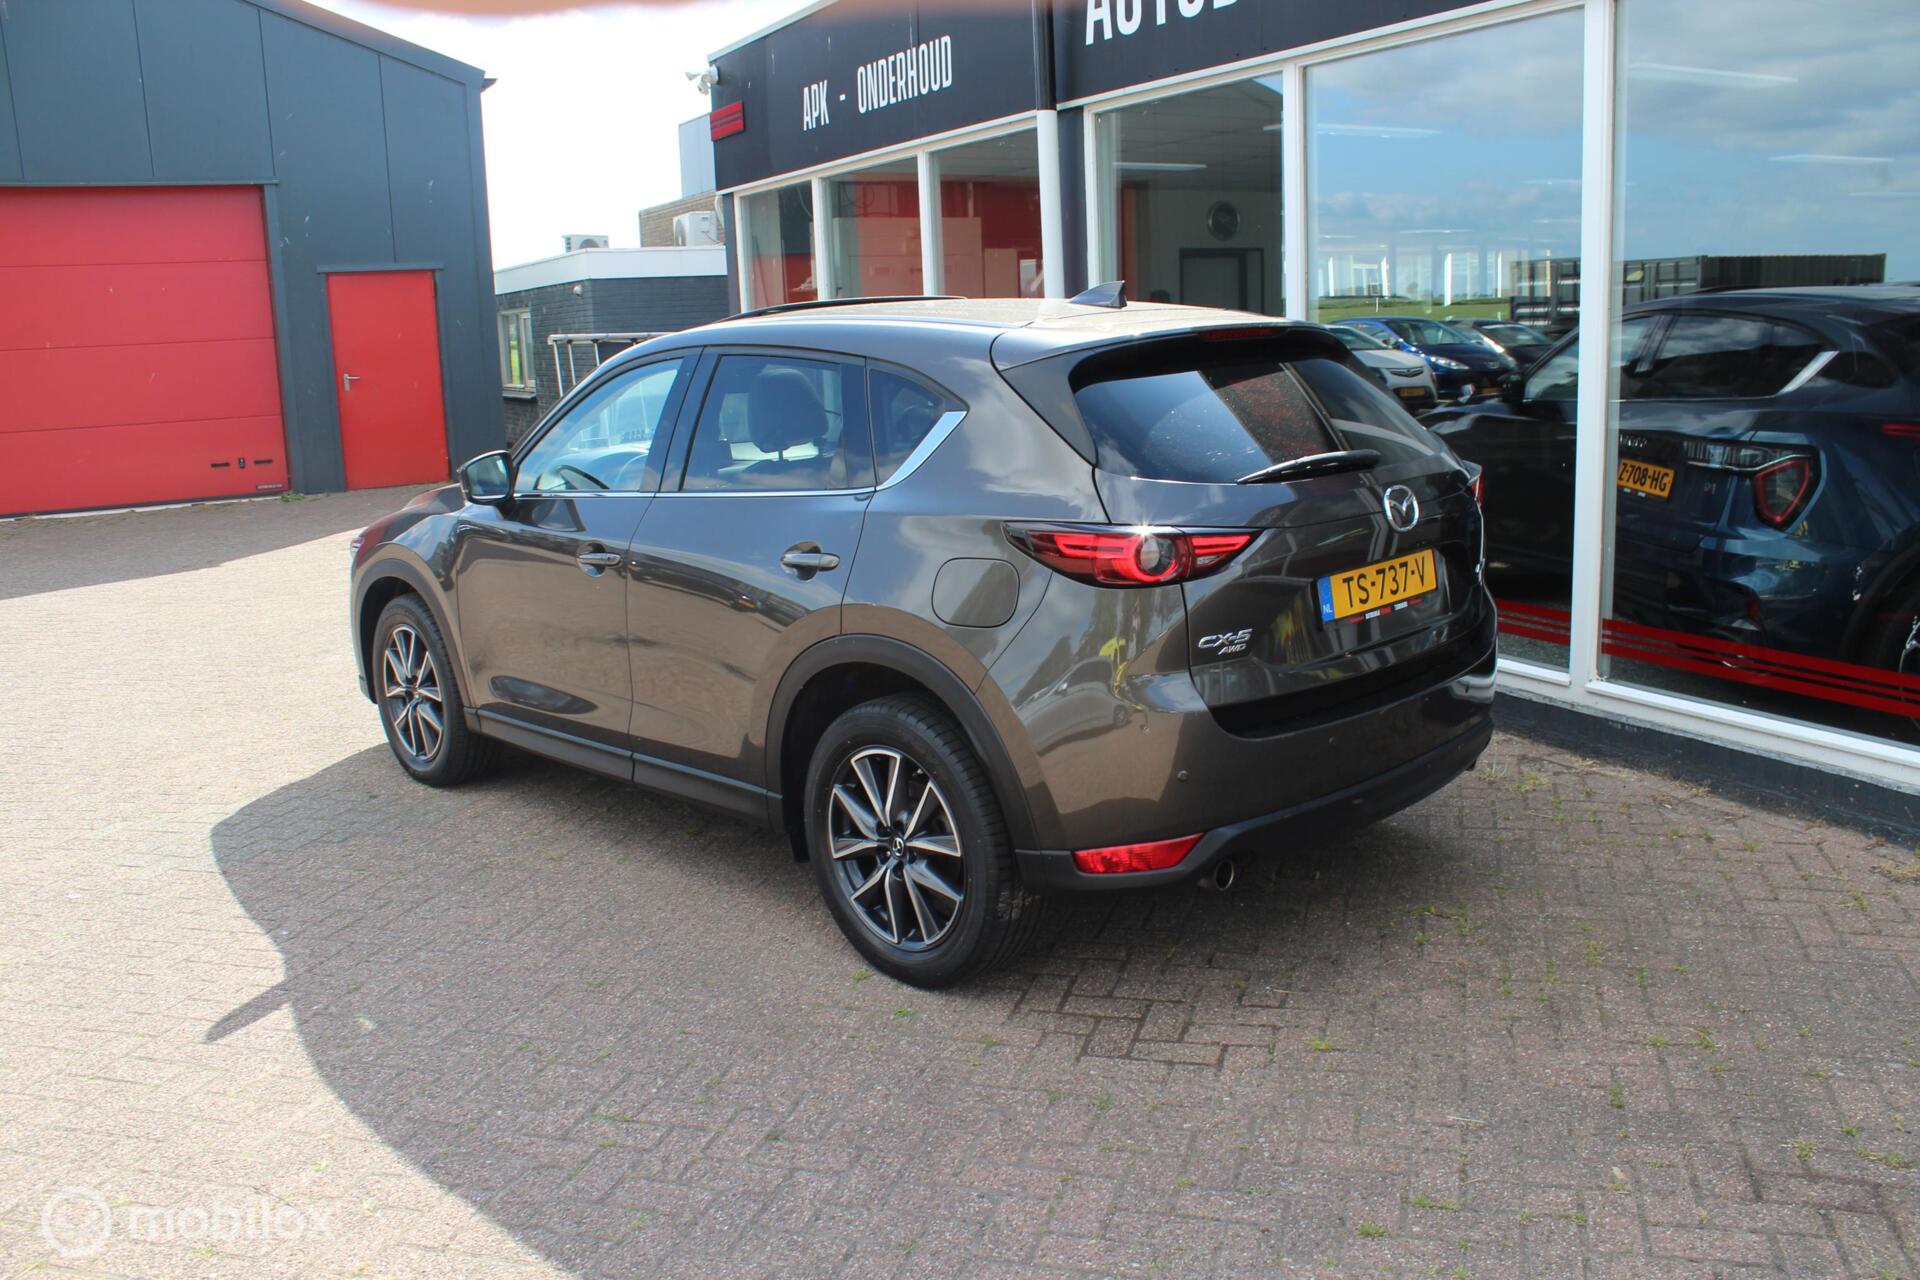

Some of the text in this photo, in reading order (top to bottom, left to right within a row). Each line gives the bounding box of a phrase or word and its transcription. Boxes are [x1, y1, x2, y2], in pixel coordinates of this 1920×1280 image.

[803, 79, 830, 131] APK
[857, 34, 953, 114] ONDERHOUD
[1342, 556, 1425, 608] TS-737-V
[1322, 603, 1333, 614] NL
[1217, 643, 1247, 656] AWD
